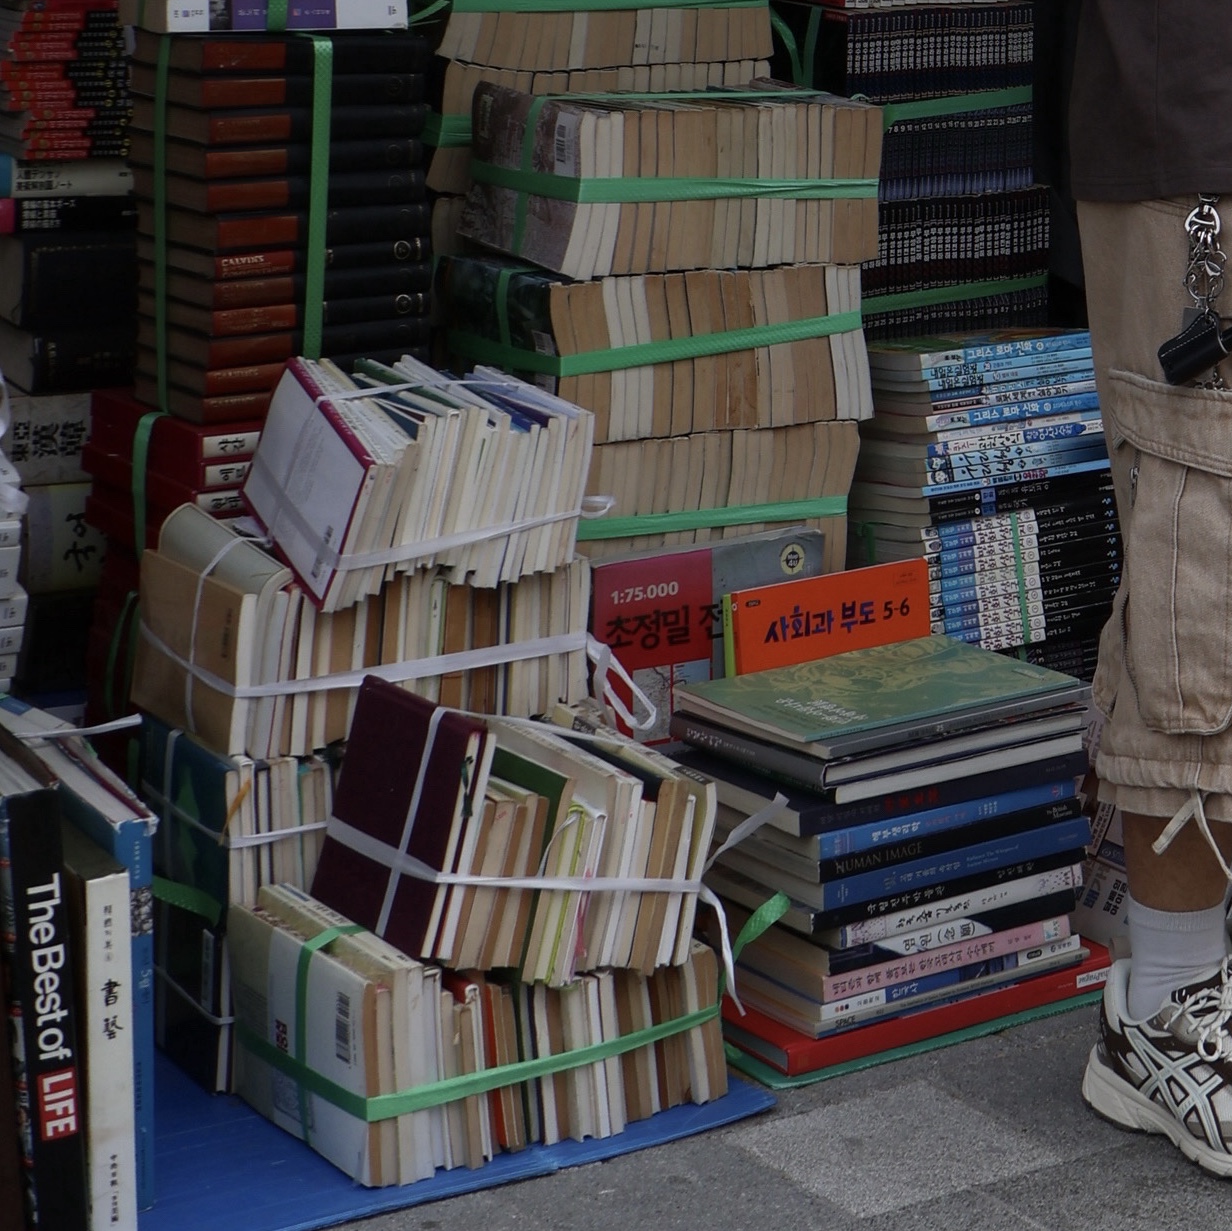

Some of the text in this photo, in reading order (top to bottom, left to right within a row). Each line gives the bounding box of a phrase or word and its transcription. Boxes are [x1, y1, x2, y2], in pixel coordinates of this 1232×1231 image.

[973, 402, 1040, 422] 그리스 로마 신화
[605, 603, 691, 649] 초정밀
[764, 596, 910, 644] 사회과 부도 5-6
[834, 841, 924, 875] HUMAN IMAGE
[26, 872, 78, 1138] The Best of LIFE
[834, 1014, 857, 1028] SPACE
